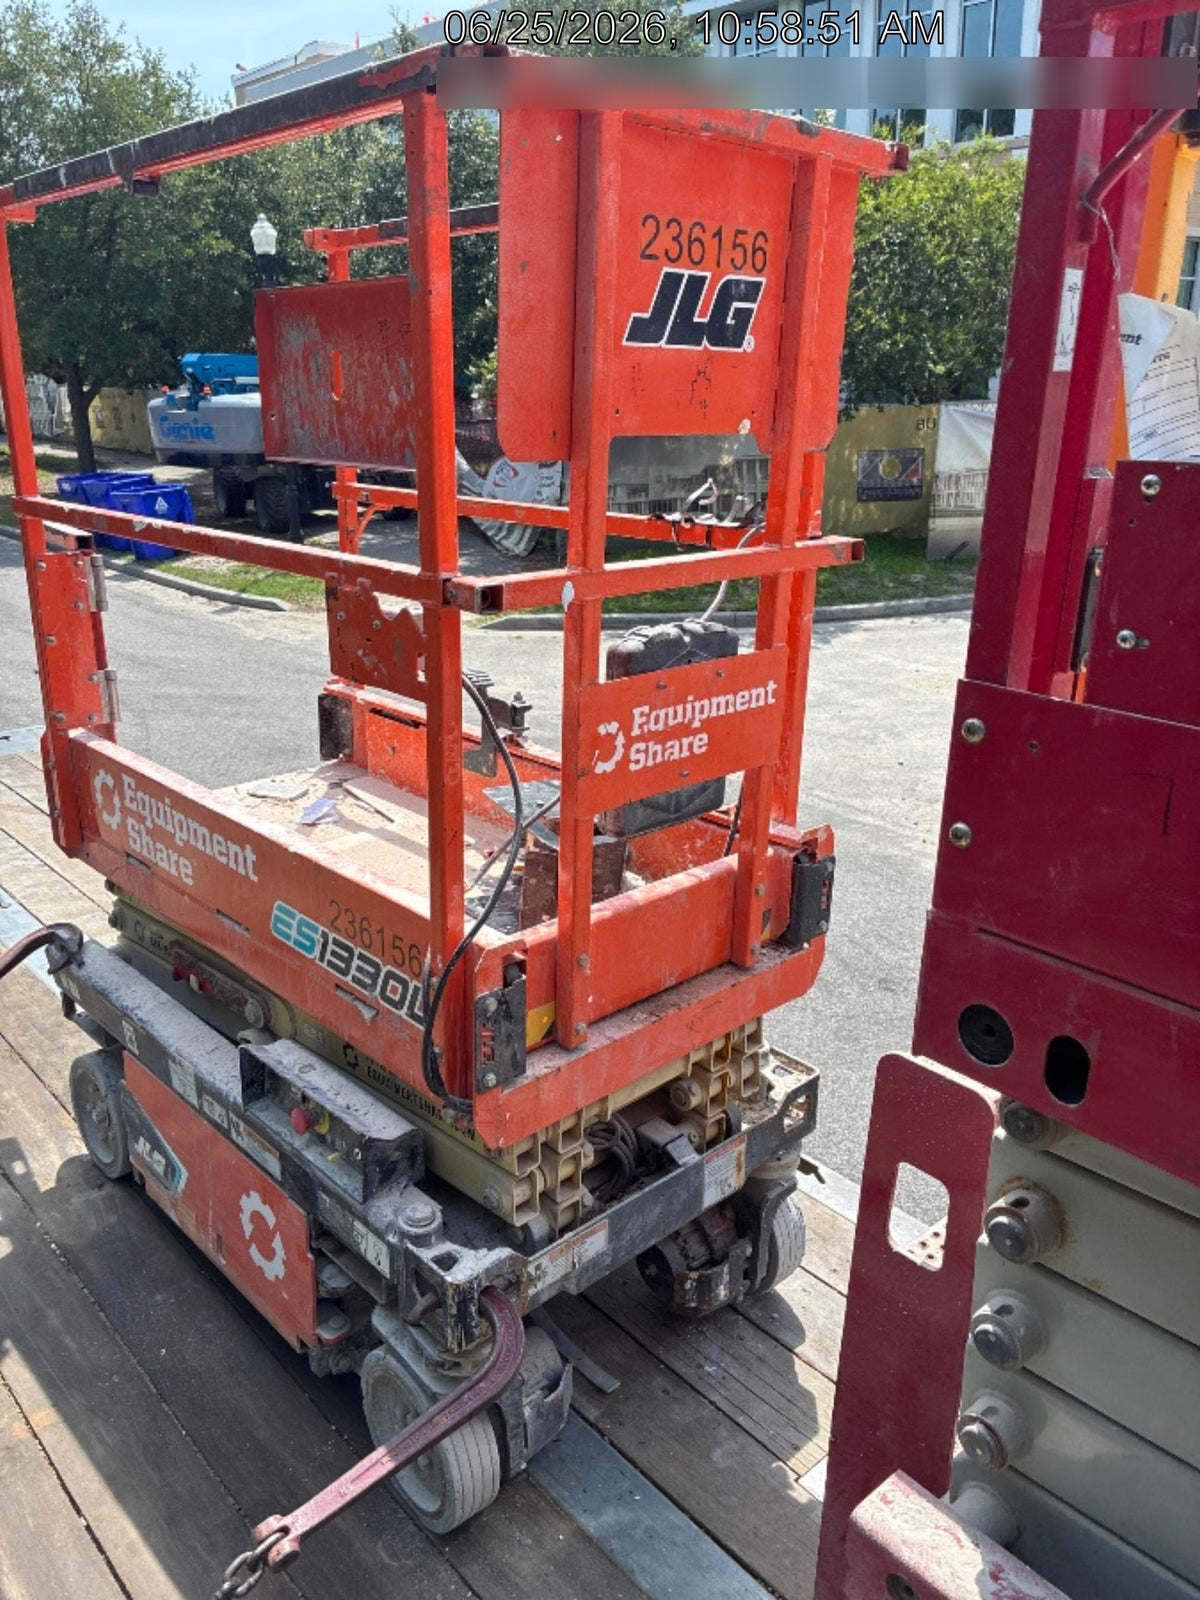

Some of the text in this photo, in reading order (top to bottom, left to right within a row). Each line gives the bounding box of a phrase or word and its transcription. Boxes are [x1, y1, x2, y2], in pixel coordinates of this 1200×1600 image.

[639, 213, 769, 274] 236156
[158, 414, 216, 441] Genie
[631, 680, 778, 736] Equipment
[629, 732, 709, 772] Share
[122, 773, 259, 883] Equipment
[126, 815, 194, 887] Share
[270, 900, 427, 1032] ES1330L
[329, 899, 423, 978] 236156
